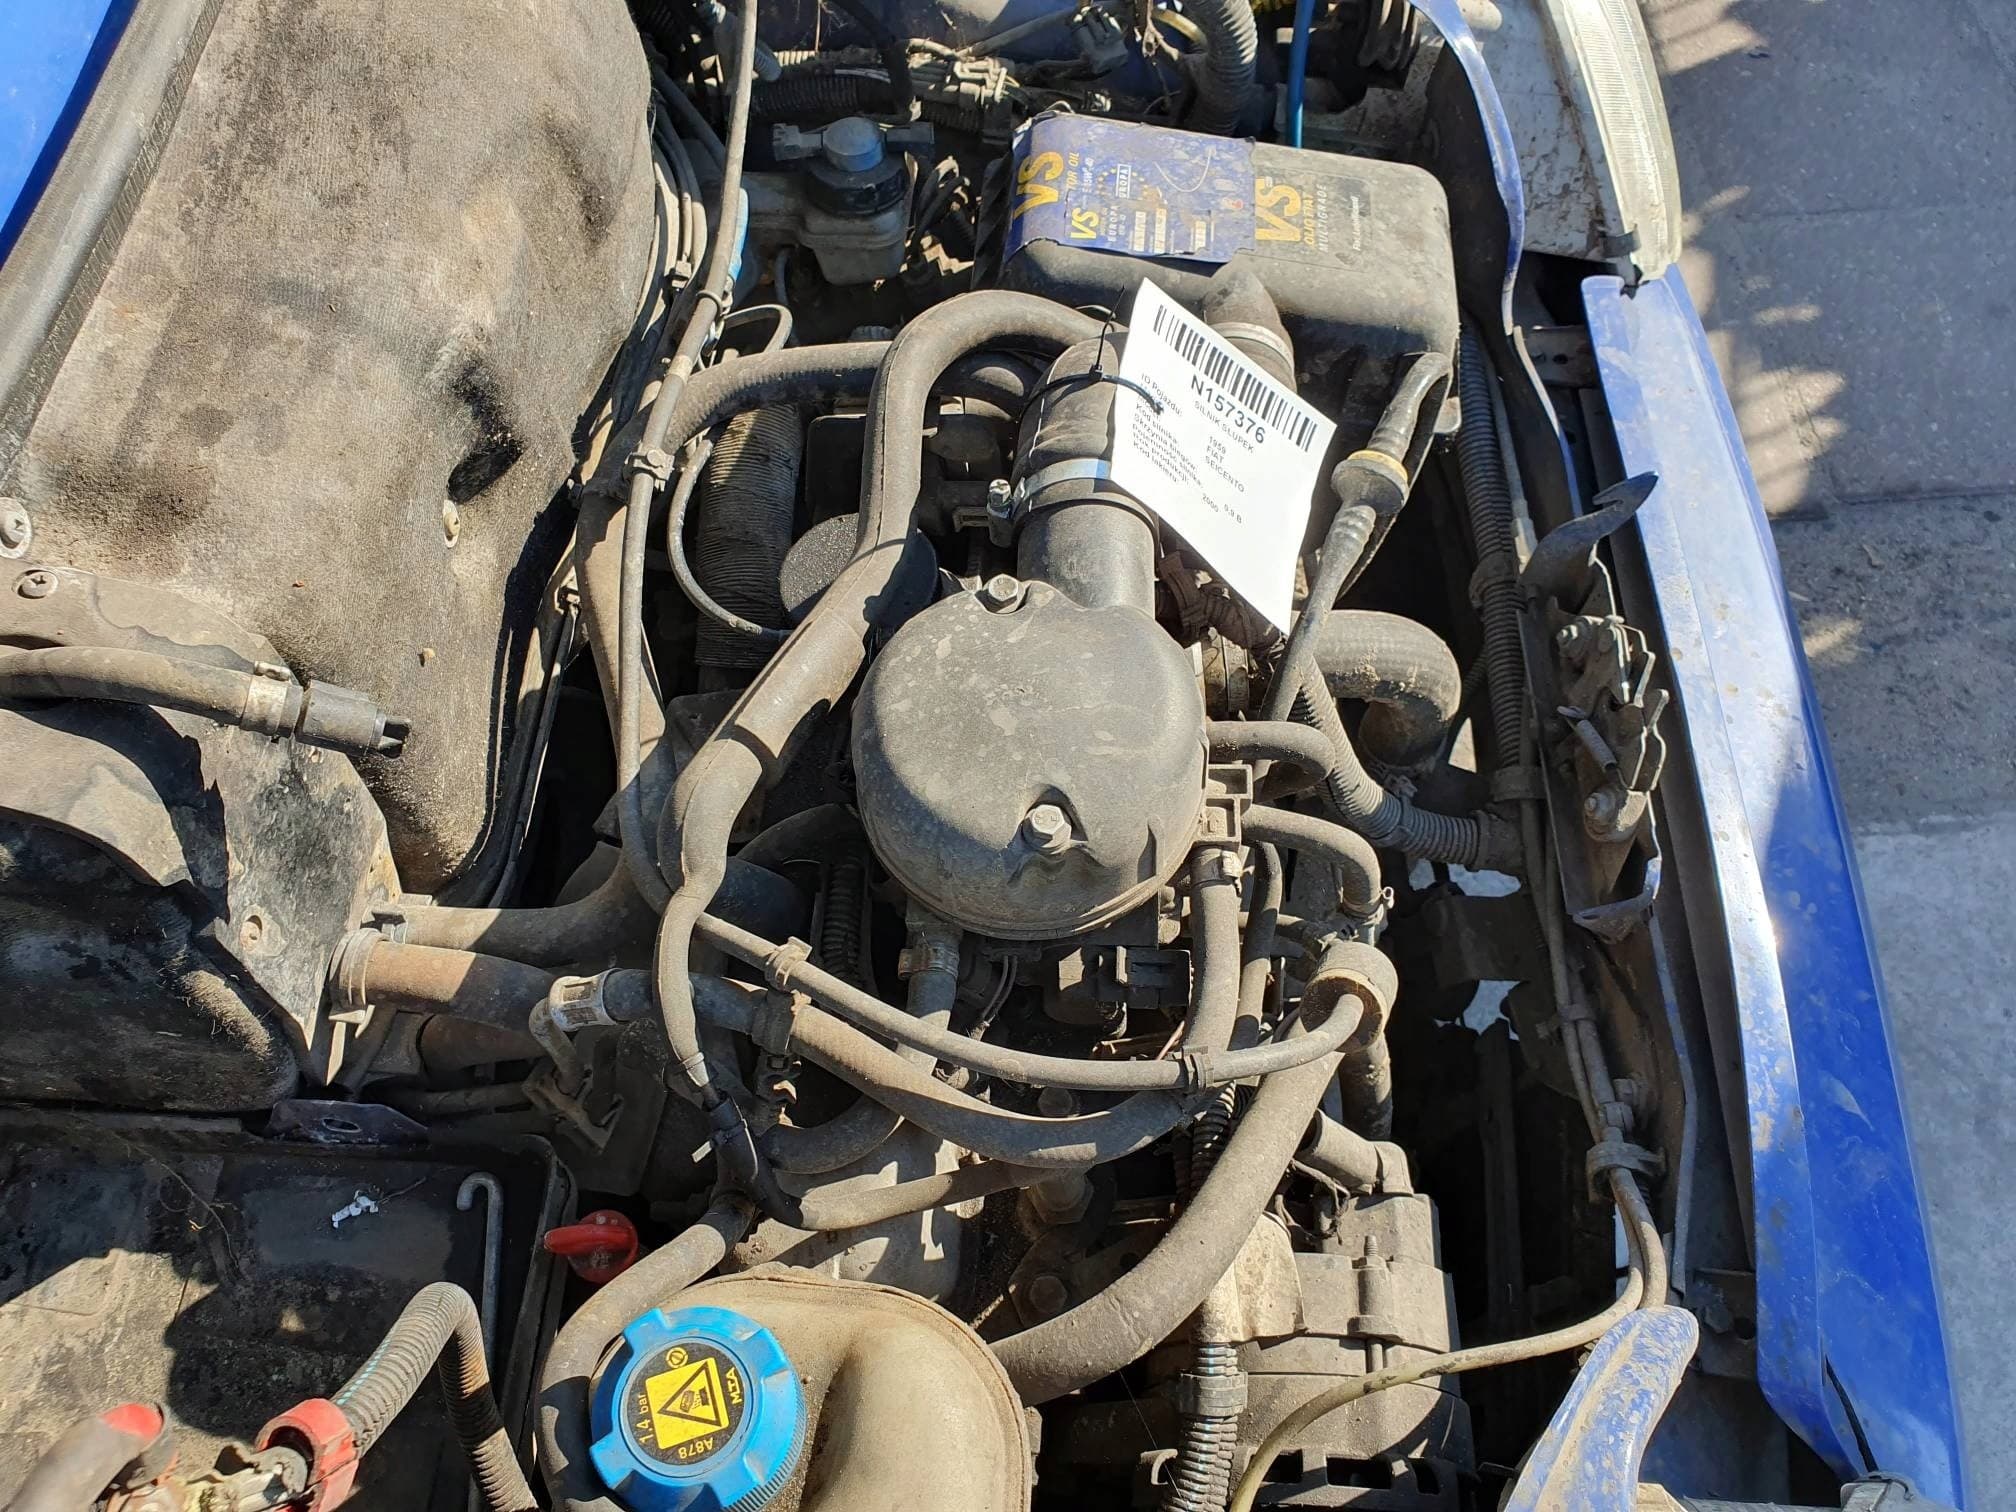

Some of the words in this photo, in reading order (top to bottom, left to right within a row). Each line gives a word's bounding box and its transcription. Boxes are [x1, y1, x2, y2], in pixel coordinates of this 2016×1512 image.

[1068, 152, 1080, 167] OIL
[1012, 151, 1064, 219] VS
[1070, 208, 1099, 239] VS
[1108, 205, 1119, 242] EUROPA
[1255, 176, 1301, 241] VS
[1316, 184, 1329, 253] MULTIGRADE
[1152, 382, 1182, 417] Pojazdu:
[1191, 374, 1265, 444] N157376
[1194, 400, 1221, 427] SILNIK
[1206, 445, 1225, 463] FIAT
[1206, 455, 1245, 493] SEICENTO
[725, 1367, 742, 1404] MTA
[638, 1394, 650, 1415] bar
[636, 1419, 654, 1443] 1.4
[678, 1437, 714, 1459] A878
